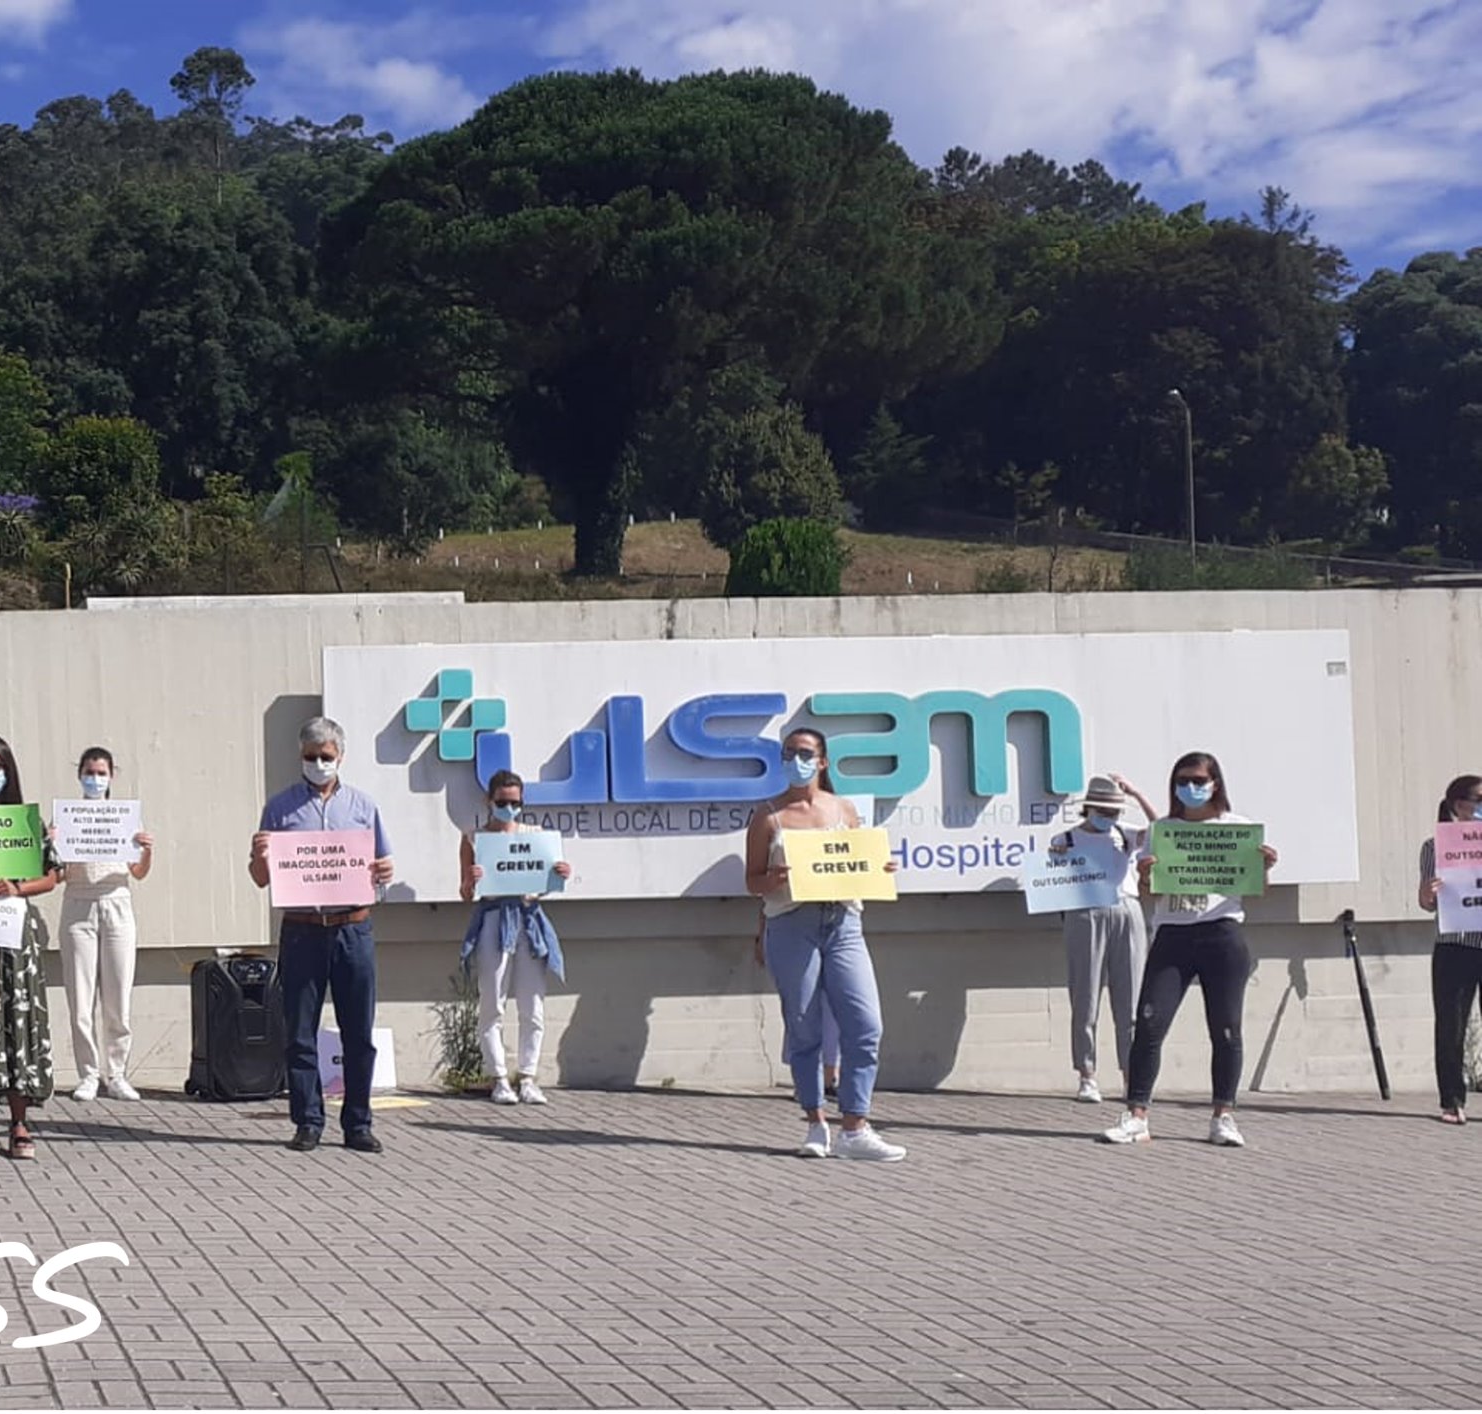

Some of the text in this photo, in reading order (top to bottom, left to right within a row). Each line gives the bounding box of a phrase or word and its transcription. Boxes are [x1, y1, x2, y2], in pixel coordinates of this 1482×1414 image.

[599, 808, 681, 832] LOCAL
[688, 808, 721, 831] DE
[297, 845, 346, 855] POR UMA
[509, 843, 532, 854] EM
[823, 842, 850, 854] EM
[278, 858, 366, 869] IMAGIOLOGIA DA
[496, 861, 544, 872] GREVE
[812, 860, 869, 874] GREVE
[1046, 857, 1086, 868] NÃO AO
[302, 873, 341, 882] ULSAM!
